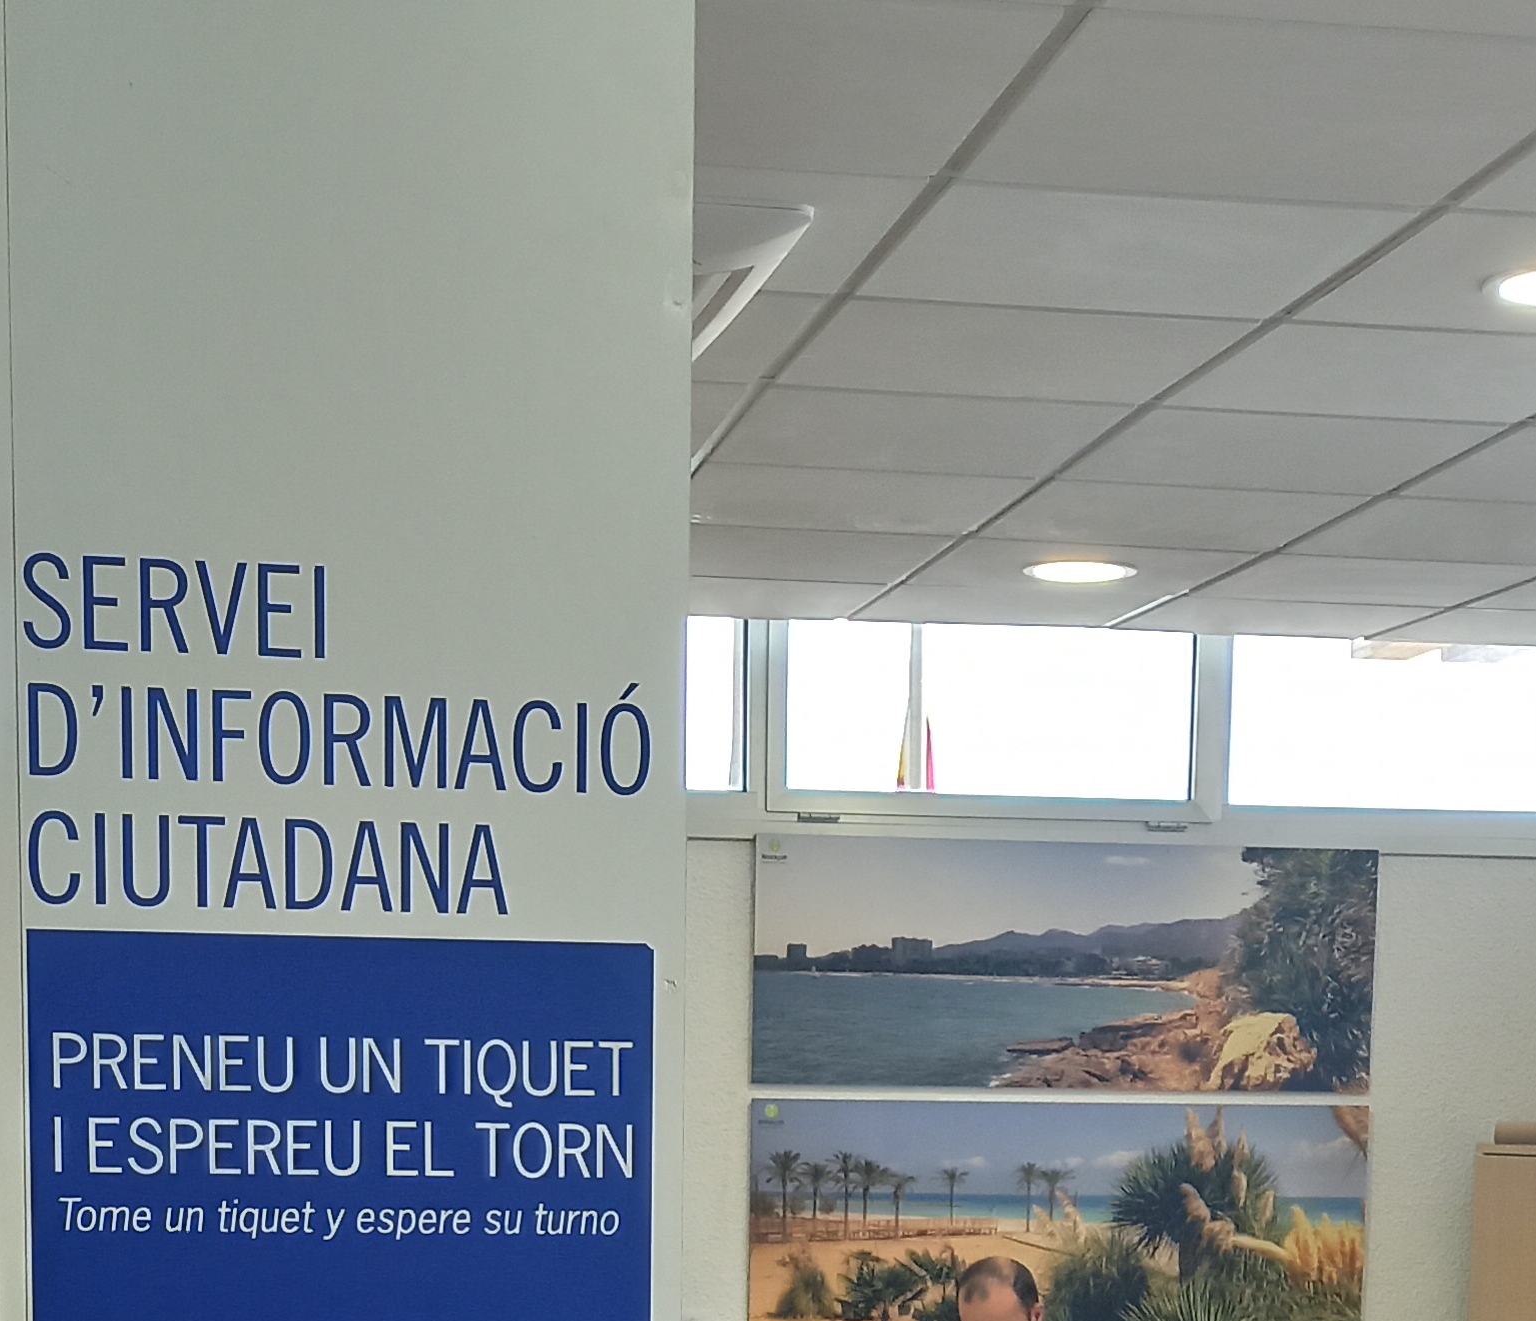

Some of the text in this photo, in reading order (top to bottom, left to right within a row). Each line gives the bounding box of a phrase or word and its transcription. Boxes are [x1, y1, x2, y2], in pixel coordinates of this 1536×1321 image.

[24, 553, 326, 659] SERVEI
[28, 683, 651, 795] D'INFORMACIÓ
[29, 811, 509, 915] CIUTADANA
[53, 1032, 633, 1107] PRENEU UN TIQUET
[54, 1117, 62, 1172] I
[89, 1117, 360, 1176] ESPEREU
[387, 1121, 454, 1176] EL
[476, 1122, 632, 1178] TORN
[59, 1198, 619, 1240] Tome un tiquet y espere su turno
